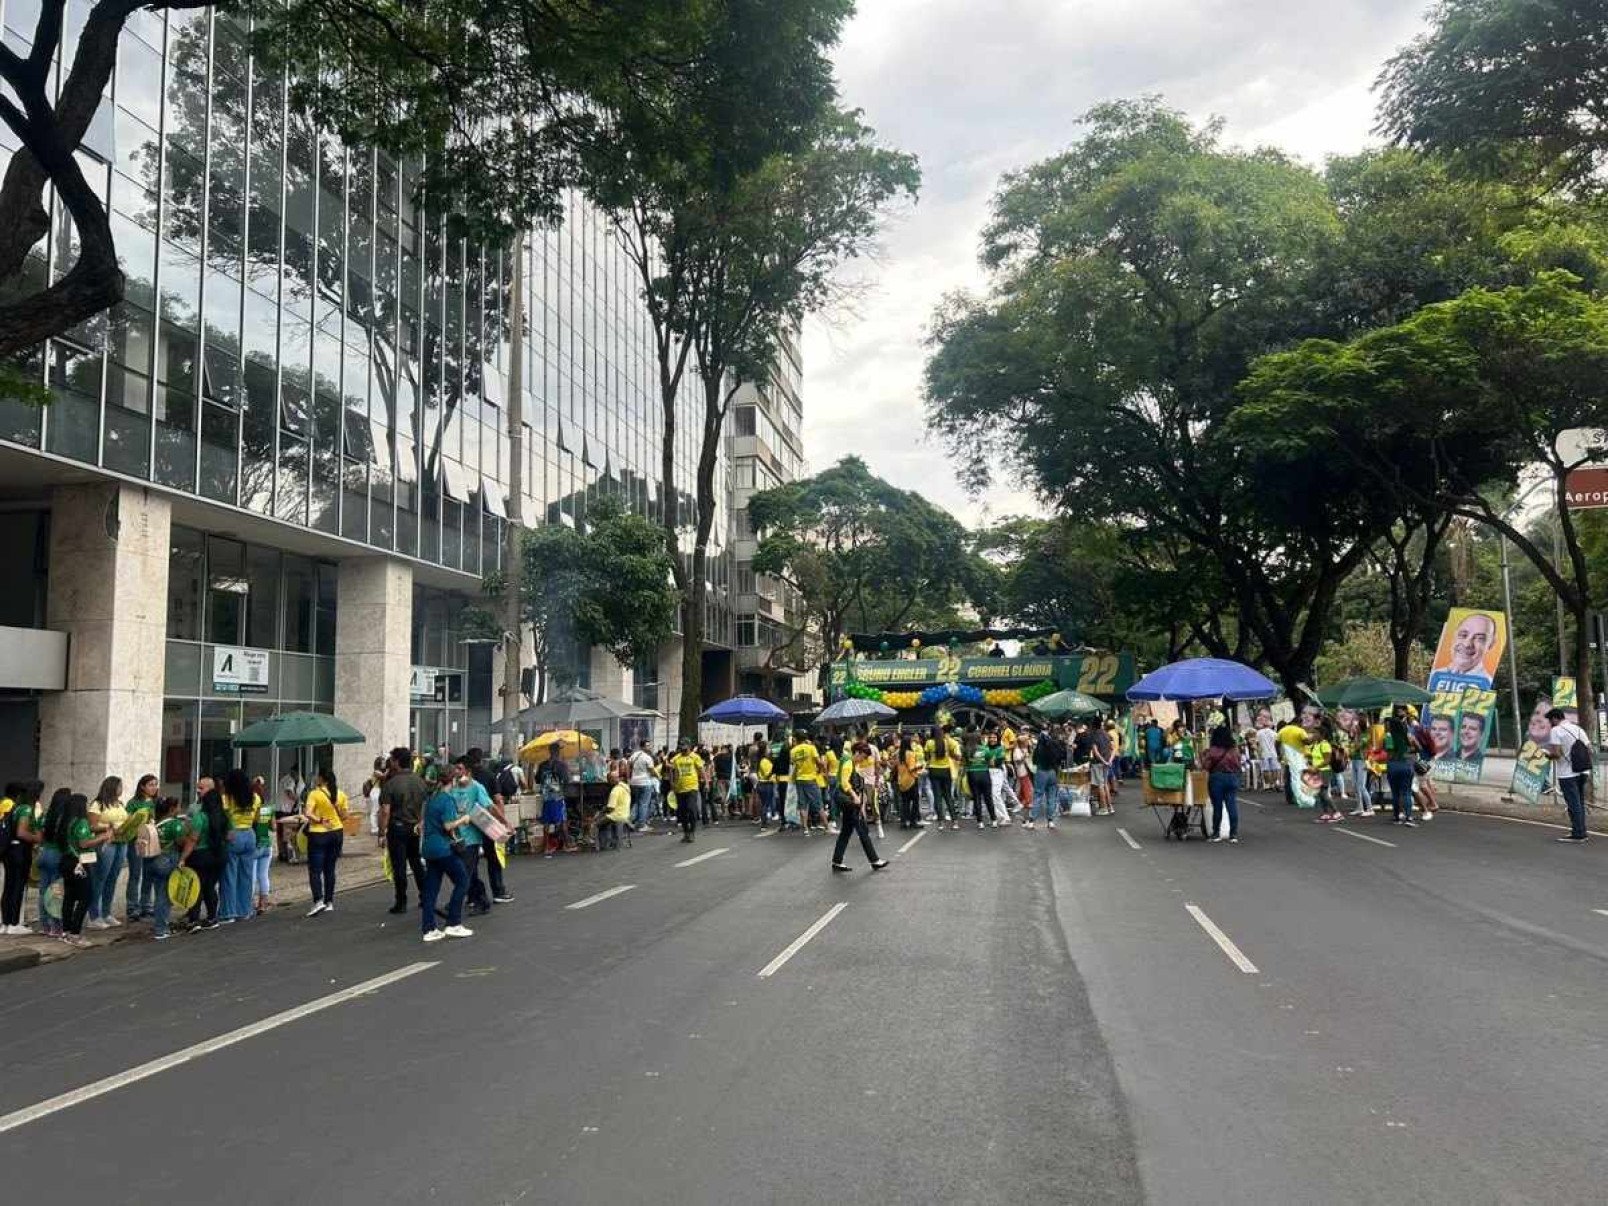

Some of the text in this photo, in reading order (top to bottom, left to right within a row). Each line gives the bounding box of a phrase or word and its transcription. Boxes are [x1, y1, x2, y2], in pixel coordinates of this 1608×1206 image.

[832, 670, 846, 684] 22
[936, 656, 962, 682] 22
[968, 665, 1010, 678] CORONEL
[1075, 655, 1120, 694] 22
[1429, 692, 1463, 715] 22
[1462, 687, 1498, 716] 22
[1553, 676, 1578, 708] 2
[1518, 741, 1550, 775] 22
